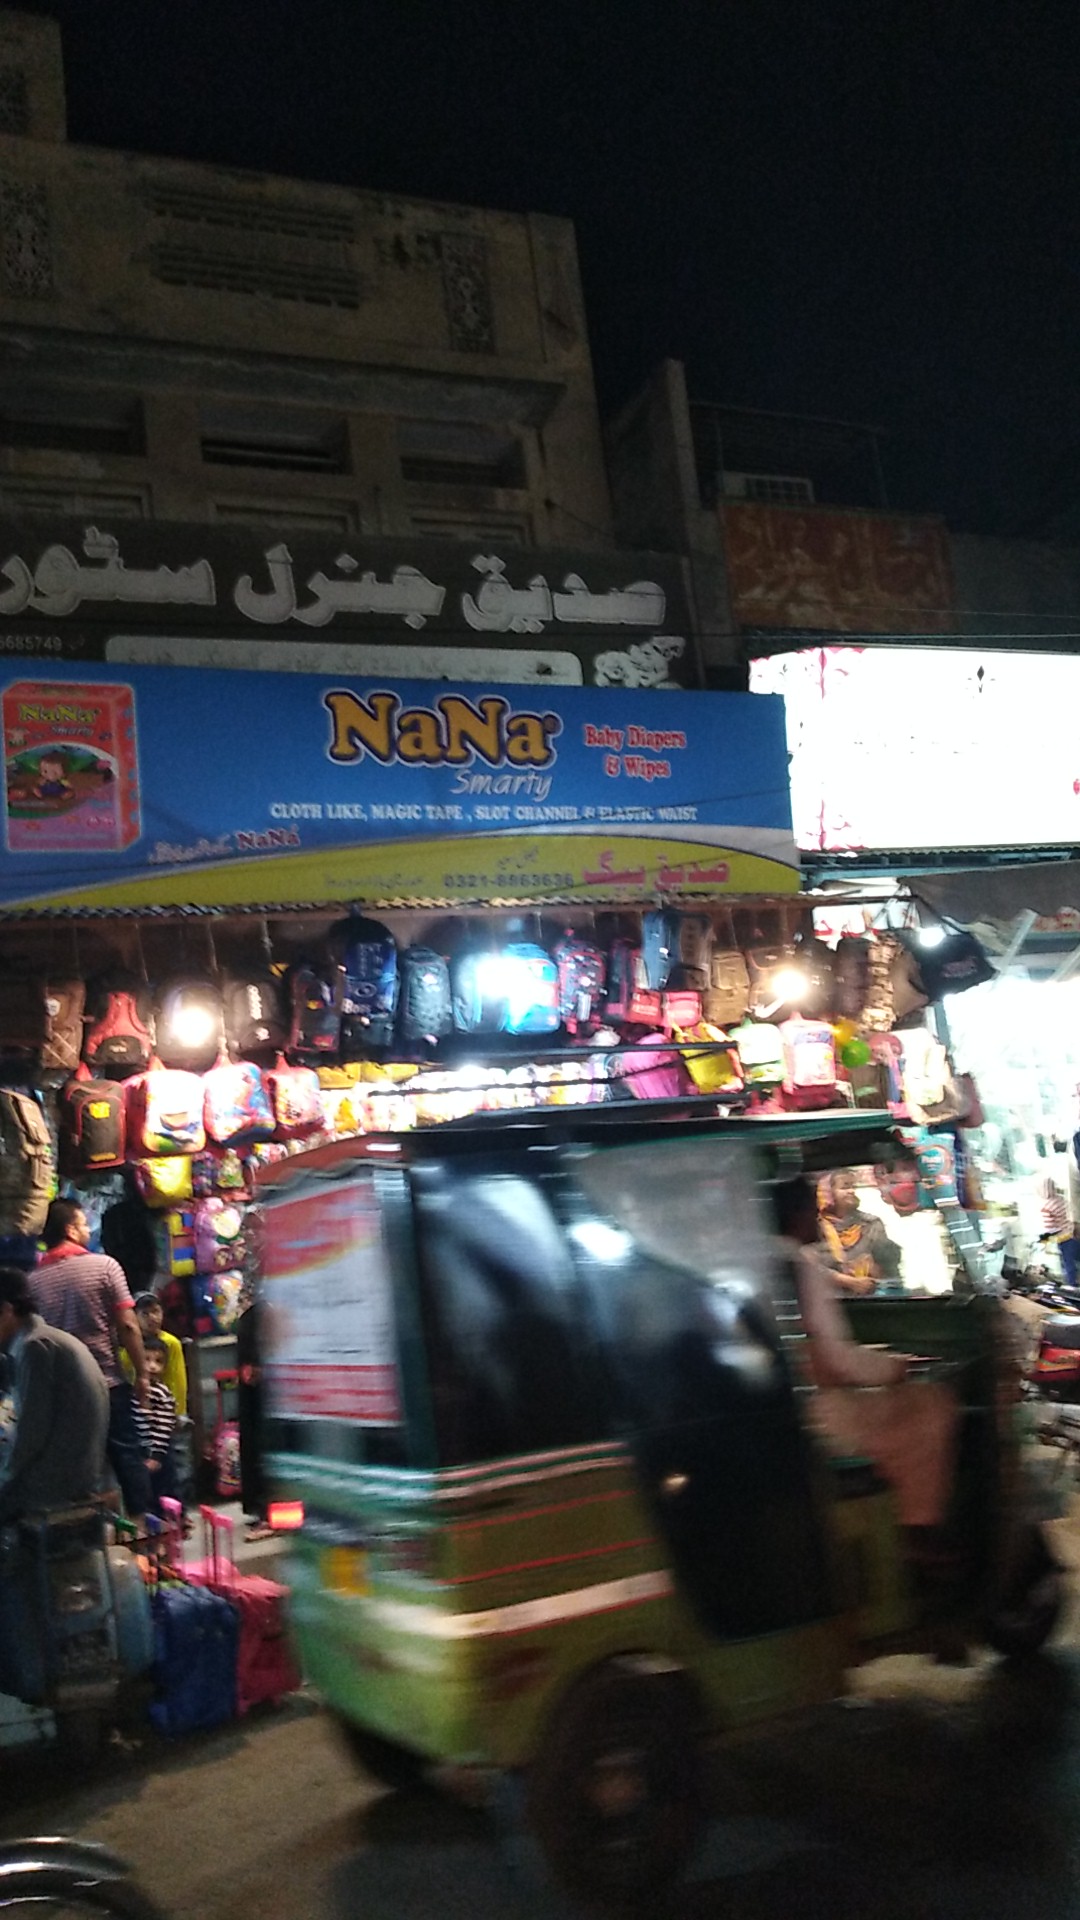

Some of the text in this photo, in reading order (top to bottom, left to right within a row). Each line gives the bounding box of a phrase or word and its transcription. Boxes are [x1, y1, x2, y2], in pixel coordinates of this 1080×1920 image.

[234, 543, 446, 630] جنرل
[324, 690, 563, 768] NaNa
[584, 724, 686, 751] Baby Diapers
[624, 757, 672, 782] Wipes
[450, 770, 553, 802] Smarty
[270, 804, 322, 819] CLOTH
[327, 804, 368, 821] LIKE,
[372, 805, 421, 820] MAGIC
[475, 806, 511, 820] SLOT
[515, 806, 579, 820] CHANNEL
[599, 806, 654, 821] ELASTIC
[658, 808, 698, 821] WAIST
